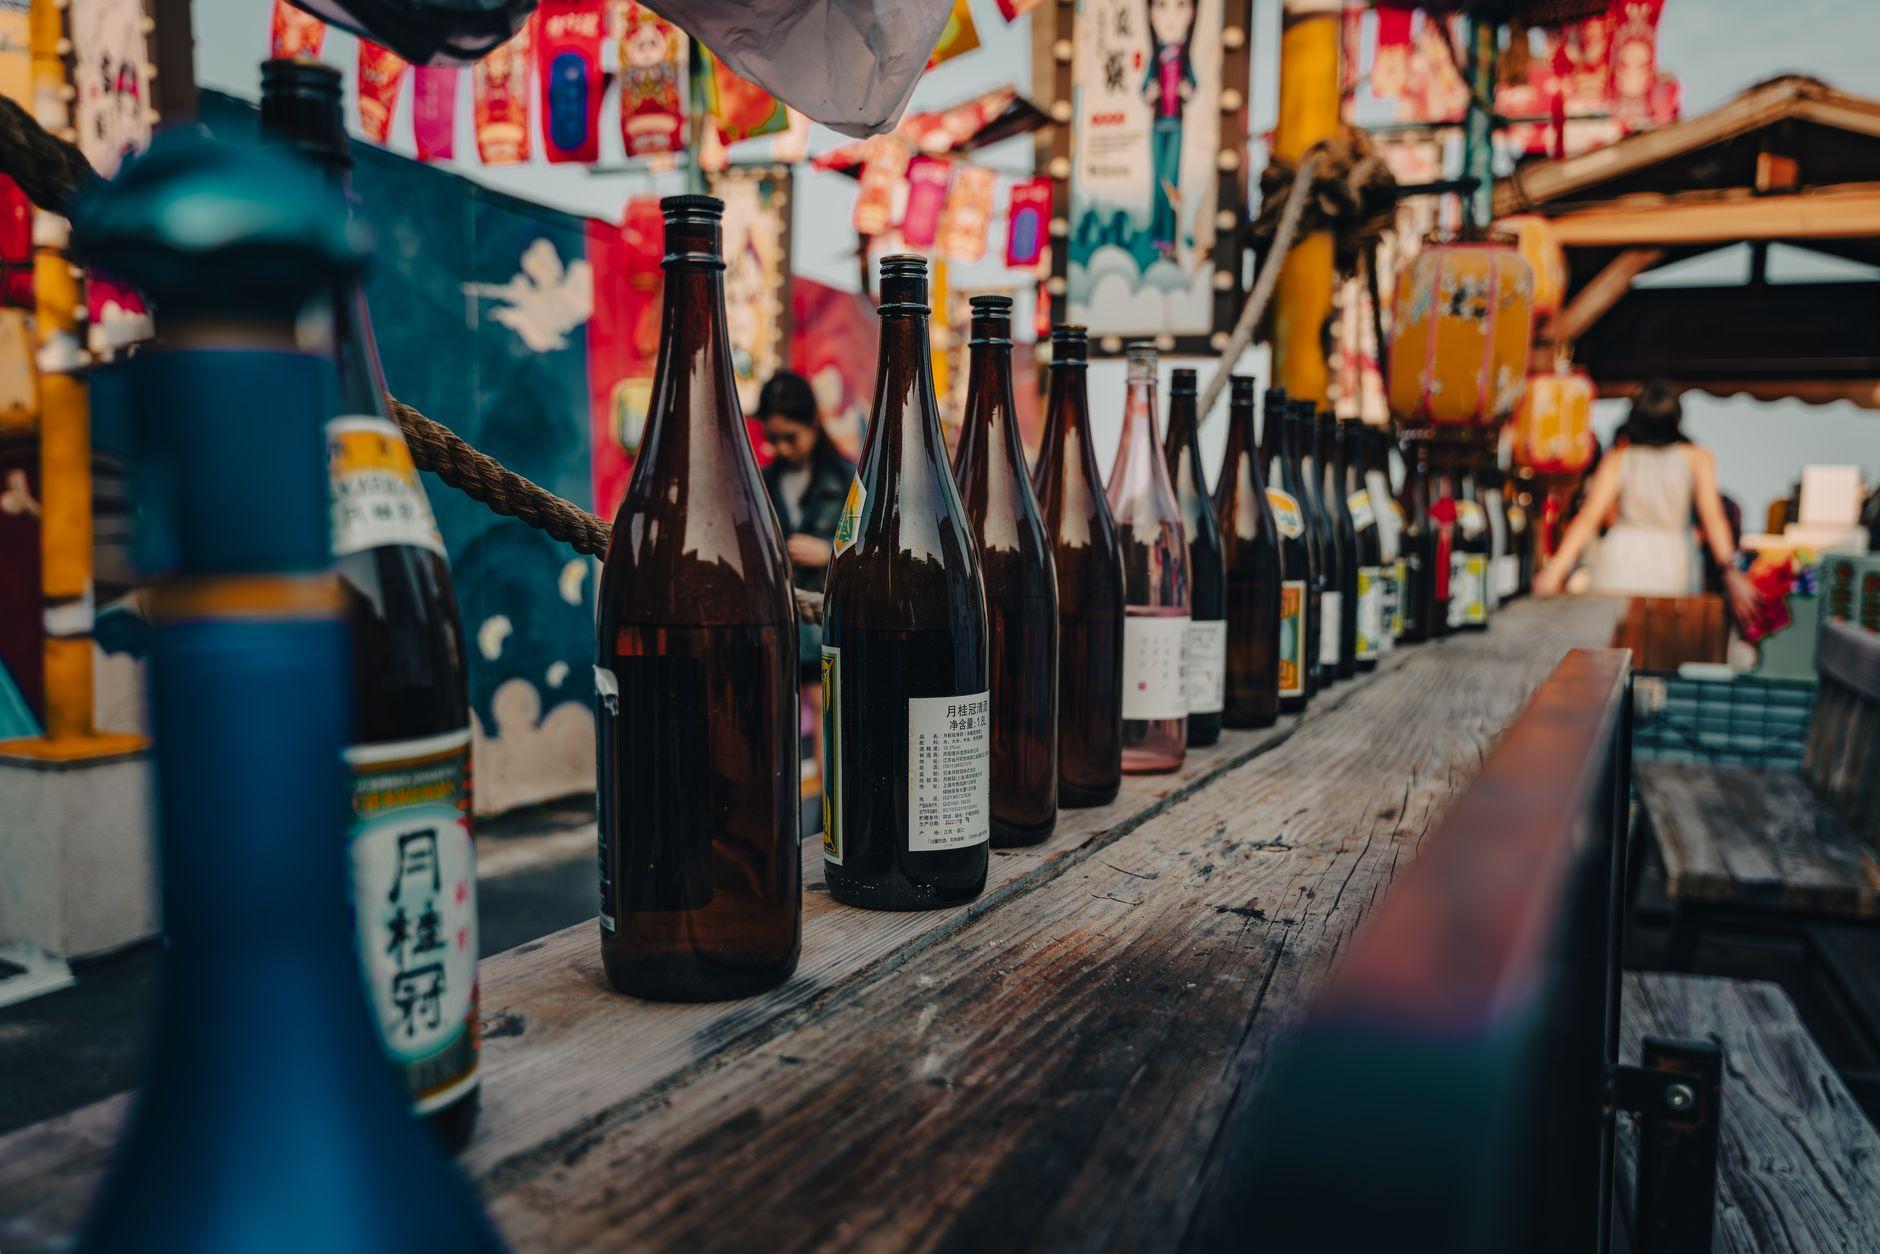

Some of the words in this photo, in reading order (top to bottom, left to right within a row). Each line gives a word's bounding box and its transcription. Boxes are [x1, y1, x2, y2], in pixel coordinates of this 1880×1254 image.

[946, 700, 988, 718] 月桂冠清酒
[387, 828, 446, 1039] 月桂冠
